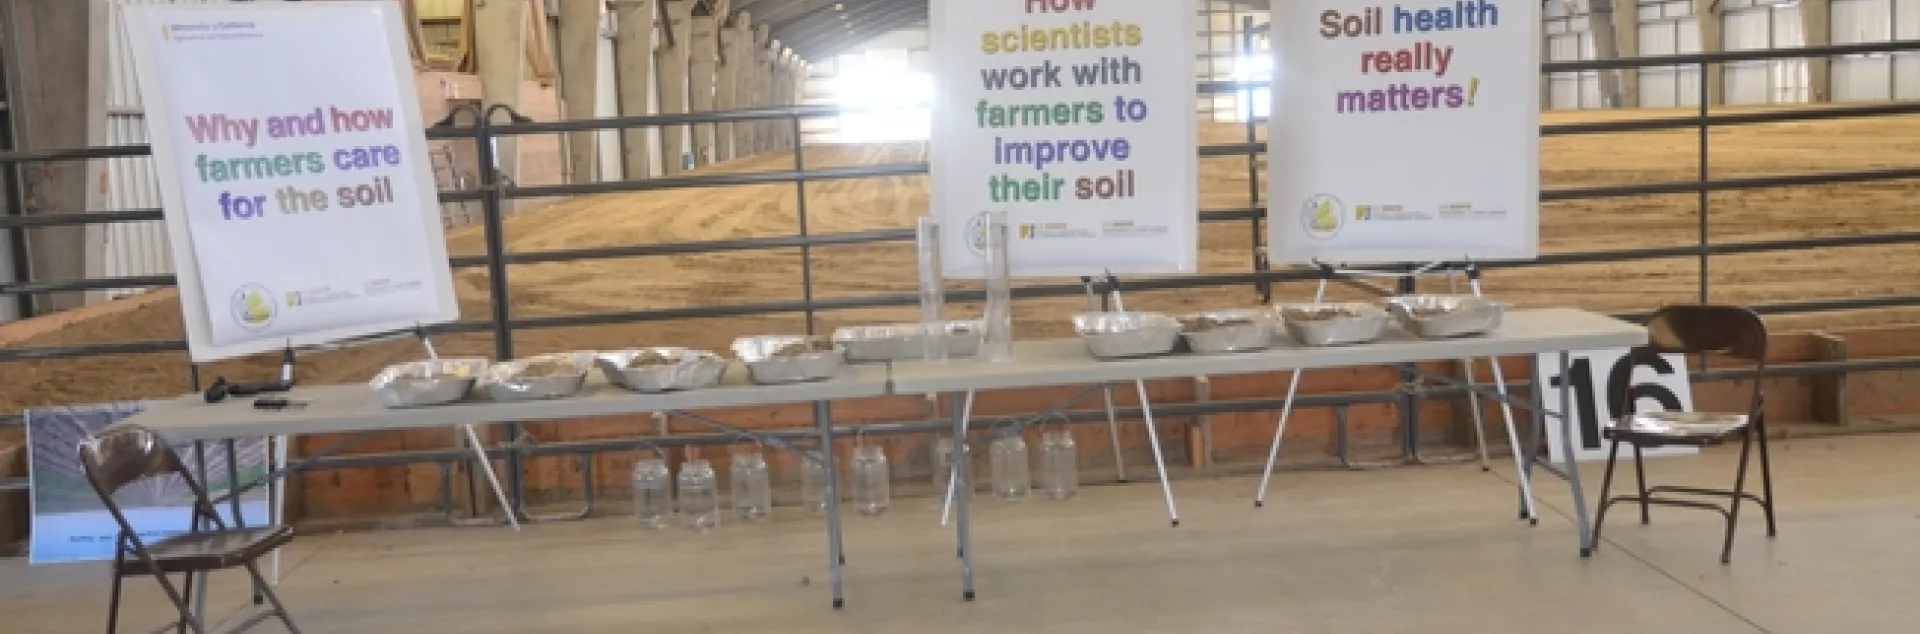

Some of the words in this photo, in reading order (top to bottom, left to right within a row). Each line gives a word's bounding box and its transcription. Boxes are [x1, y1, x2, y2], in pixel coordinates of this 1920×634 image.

[980, 20, 1142, 54] scientists
[1320, 7, 1383, 39] Soil
[1393, 0, 1498, 34] health
[980, 60, 1062, 90] work
[1072, 56, 1141, 85] with
[1361, 41, 1453, 77] really
[975, 98, 1104, 128] farmers
[1114, 95, 1147, 123] to
[1337, 76, 1480, 114] matters!
[185, 113, 259, 147] Why
[267, 107, 325, 139] and
[329, 105, 393, 132] how
[194, 151, 325, 183] farmers
[333, 144, 400, 171] care
[994, 136, 1131, 170] improve
[218, 191, 266, 220] for
[275, 185, 328, 214] the
[336, 176, 394, 209] soil
[988, 172, 1065, 202] their
[1074, 169, 1135, 201] soil
[1550, 347, 1684, 448] 16
